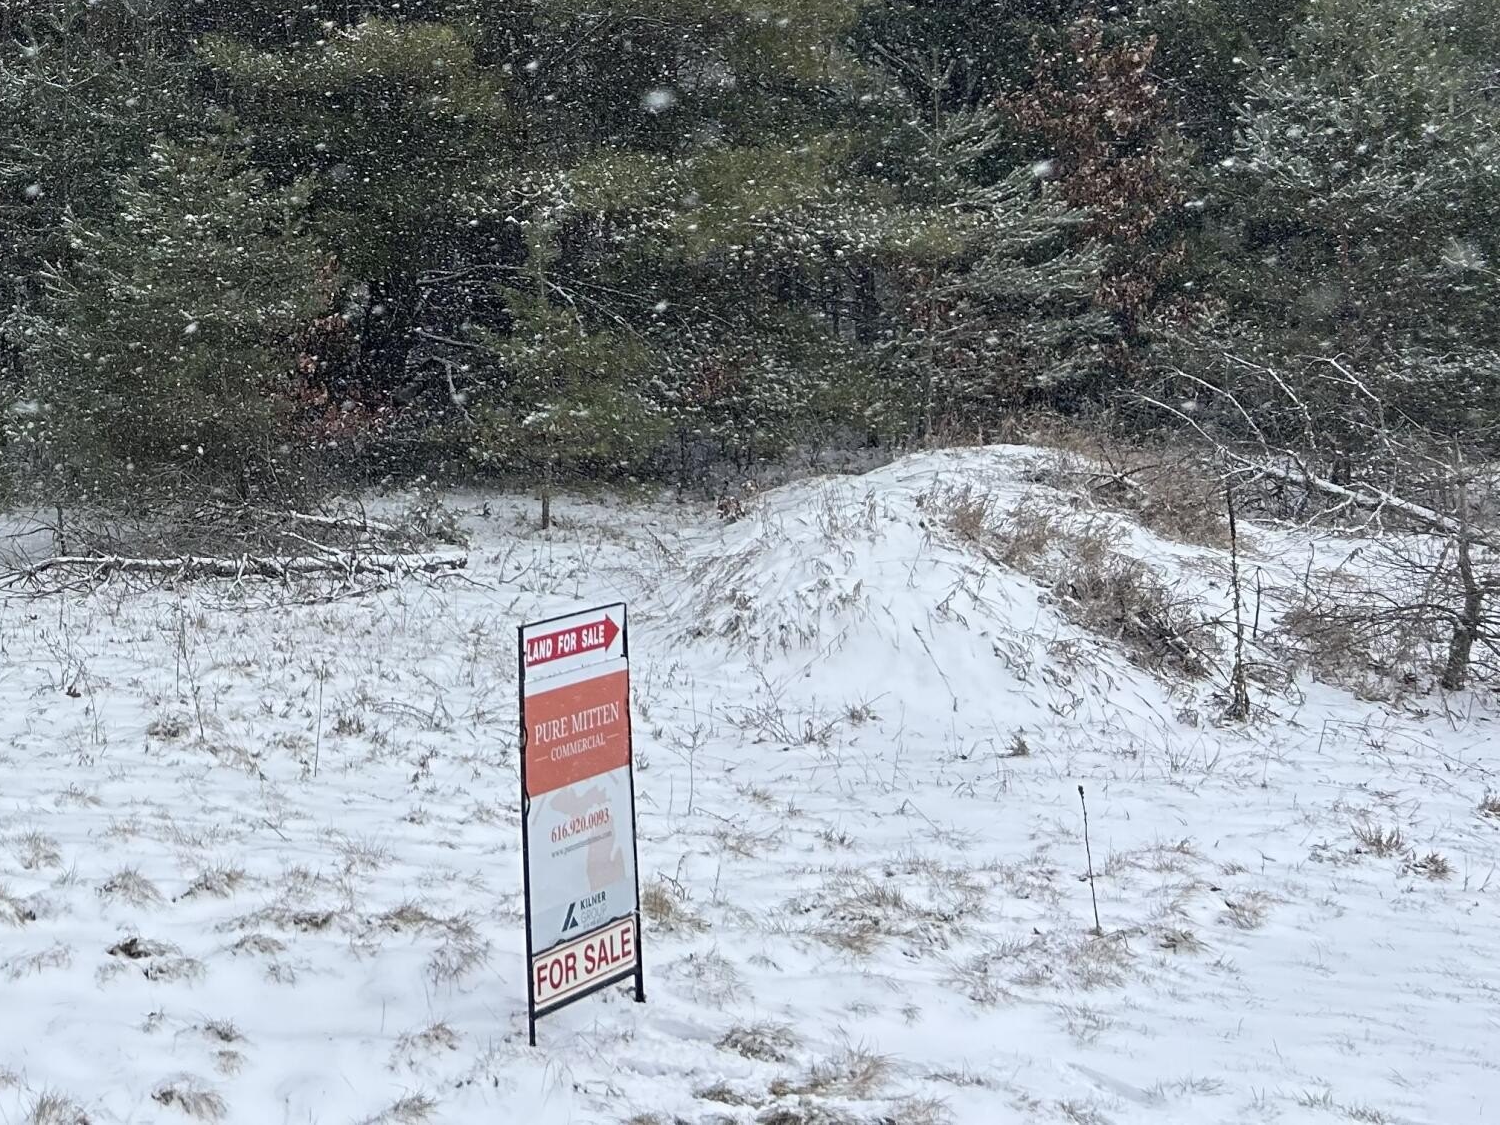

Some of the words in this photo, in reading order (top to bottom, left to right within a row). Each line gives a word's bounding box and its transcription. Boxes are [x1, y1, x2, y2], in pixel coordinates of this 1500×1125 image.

[526, 639, 552, 662] LAND
[558, 631, 577, 654] FOR
[582, 624, 605, 649] SALE
[534, 716, 569, 746] PURE
[571, 701, 620, 735] MITTEN
[551, 733, 606, 762] COMMERCIAL
[551, 807, 610, 843] 616.920.0093
[580, 891, 606, 910] KILNER
[536, 954, 577, 996] FOR
[583, 926, 632, 975] SALE
